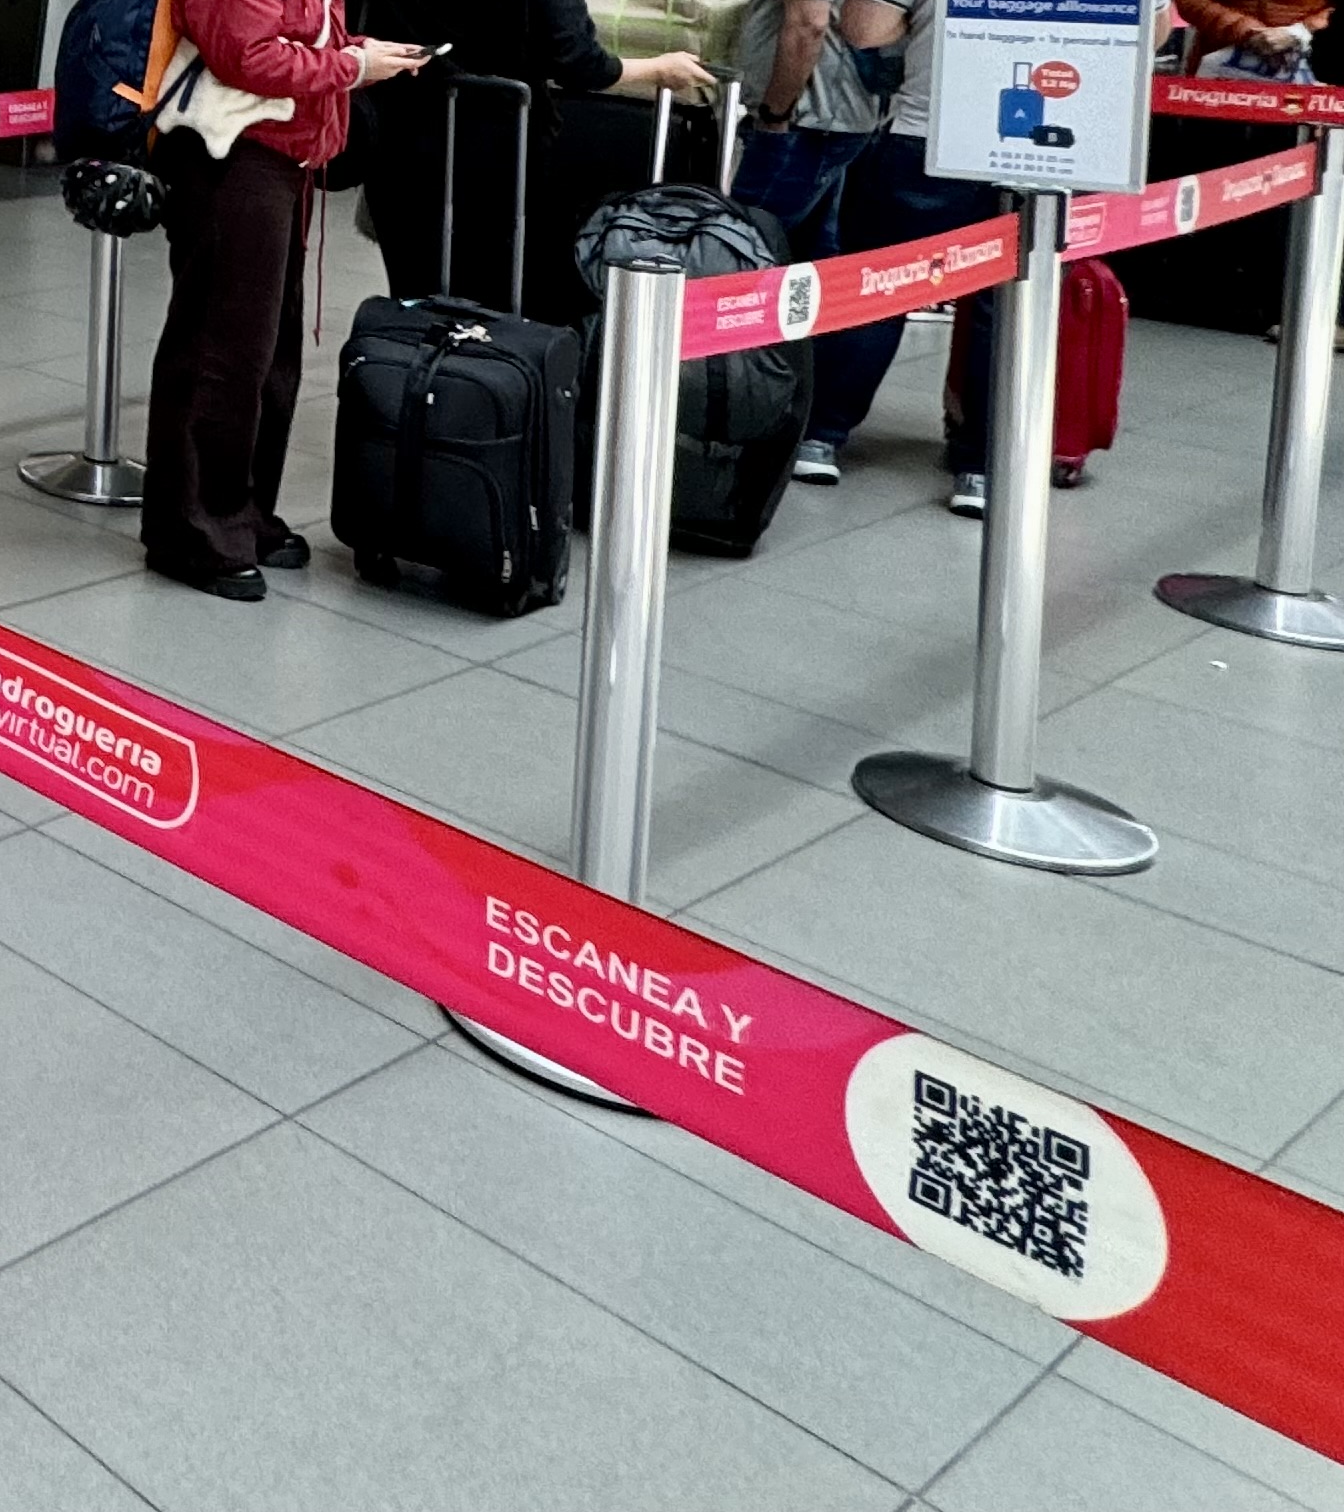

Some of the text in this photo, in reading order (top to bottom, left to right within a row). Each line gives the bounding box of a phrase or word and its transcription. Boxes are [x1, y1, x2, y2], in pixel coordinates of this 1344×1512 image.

[484, 895, 755, 1046] ESCANEA Y
[486, 941, 747, 1096] DESCUBRE
